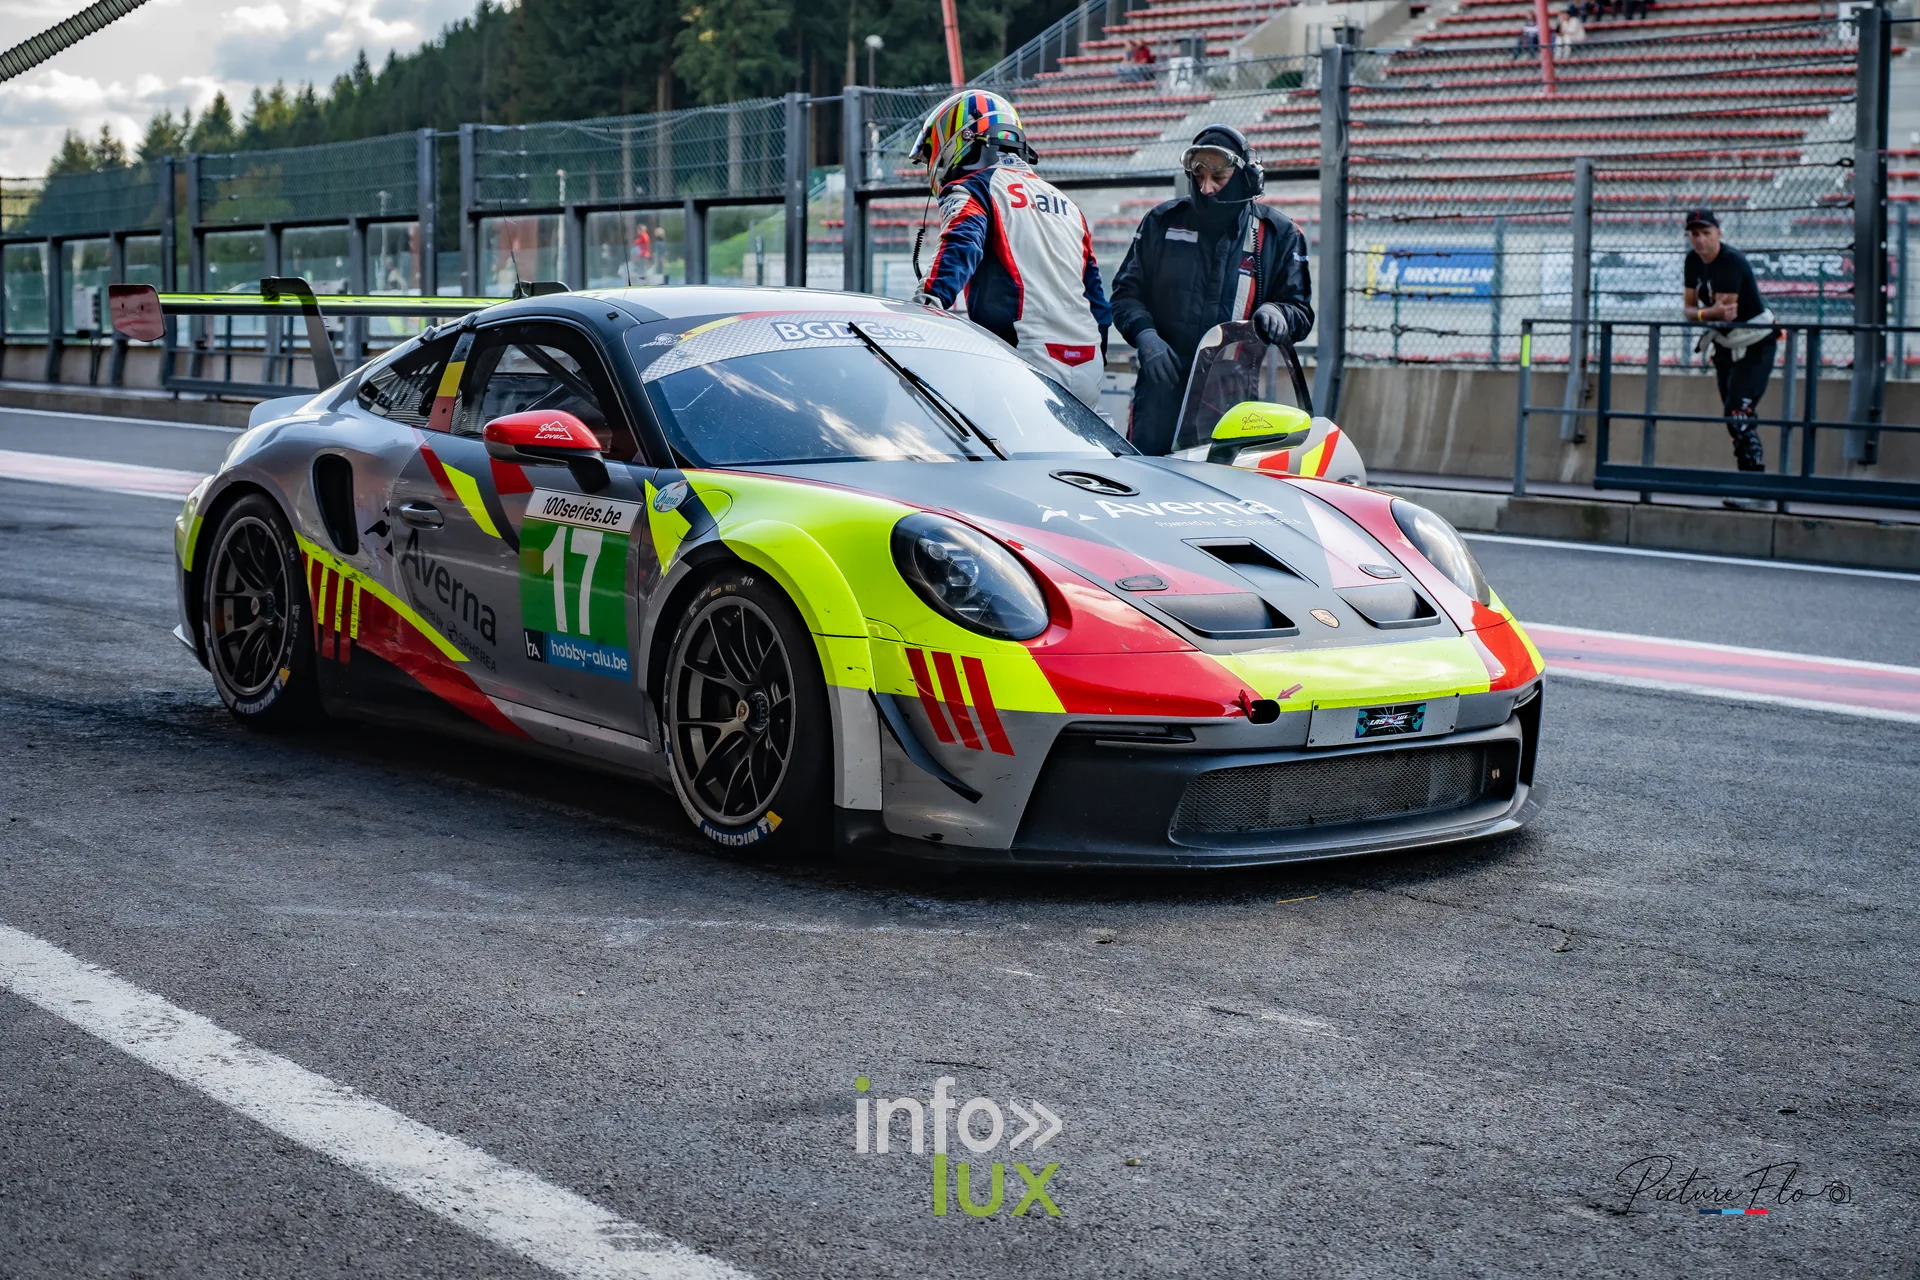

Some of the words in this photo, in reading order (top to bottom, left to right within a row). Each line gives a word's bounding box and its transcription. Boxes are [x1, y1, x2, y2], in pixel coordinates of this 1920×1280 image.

[1007, 183, 1068, 216] S.air
[1402, 266, 1495, 284] MICHELIN
[542, 496, 622, 526] 100series.be
[1094, 499, 1283, 519] Averna
[401, 528, 497, 647] Averna
[543, 525, 604, 636] 17
[458, 635, 497, 671] SPHEREA
[551, 640, 628, 672] hobby-alu.be
[235, 687, 276, 714] MICHELIN
[703, 825, 759, 846] MICHELIN
